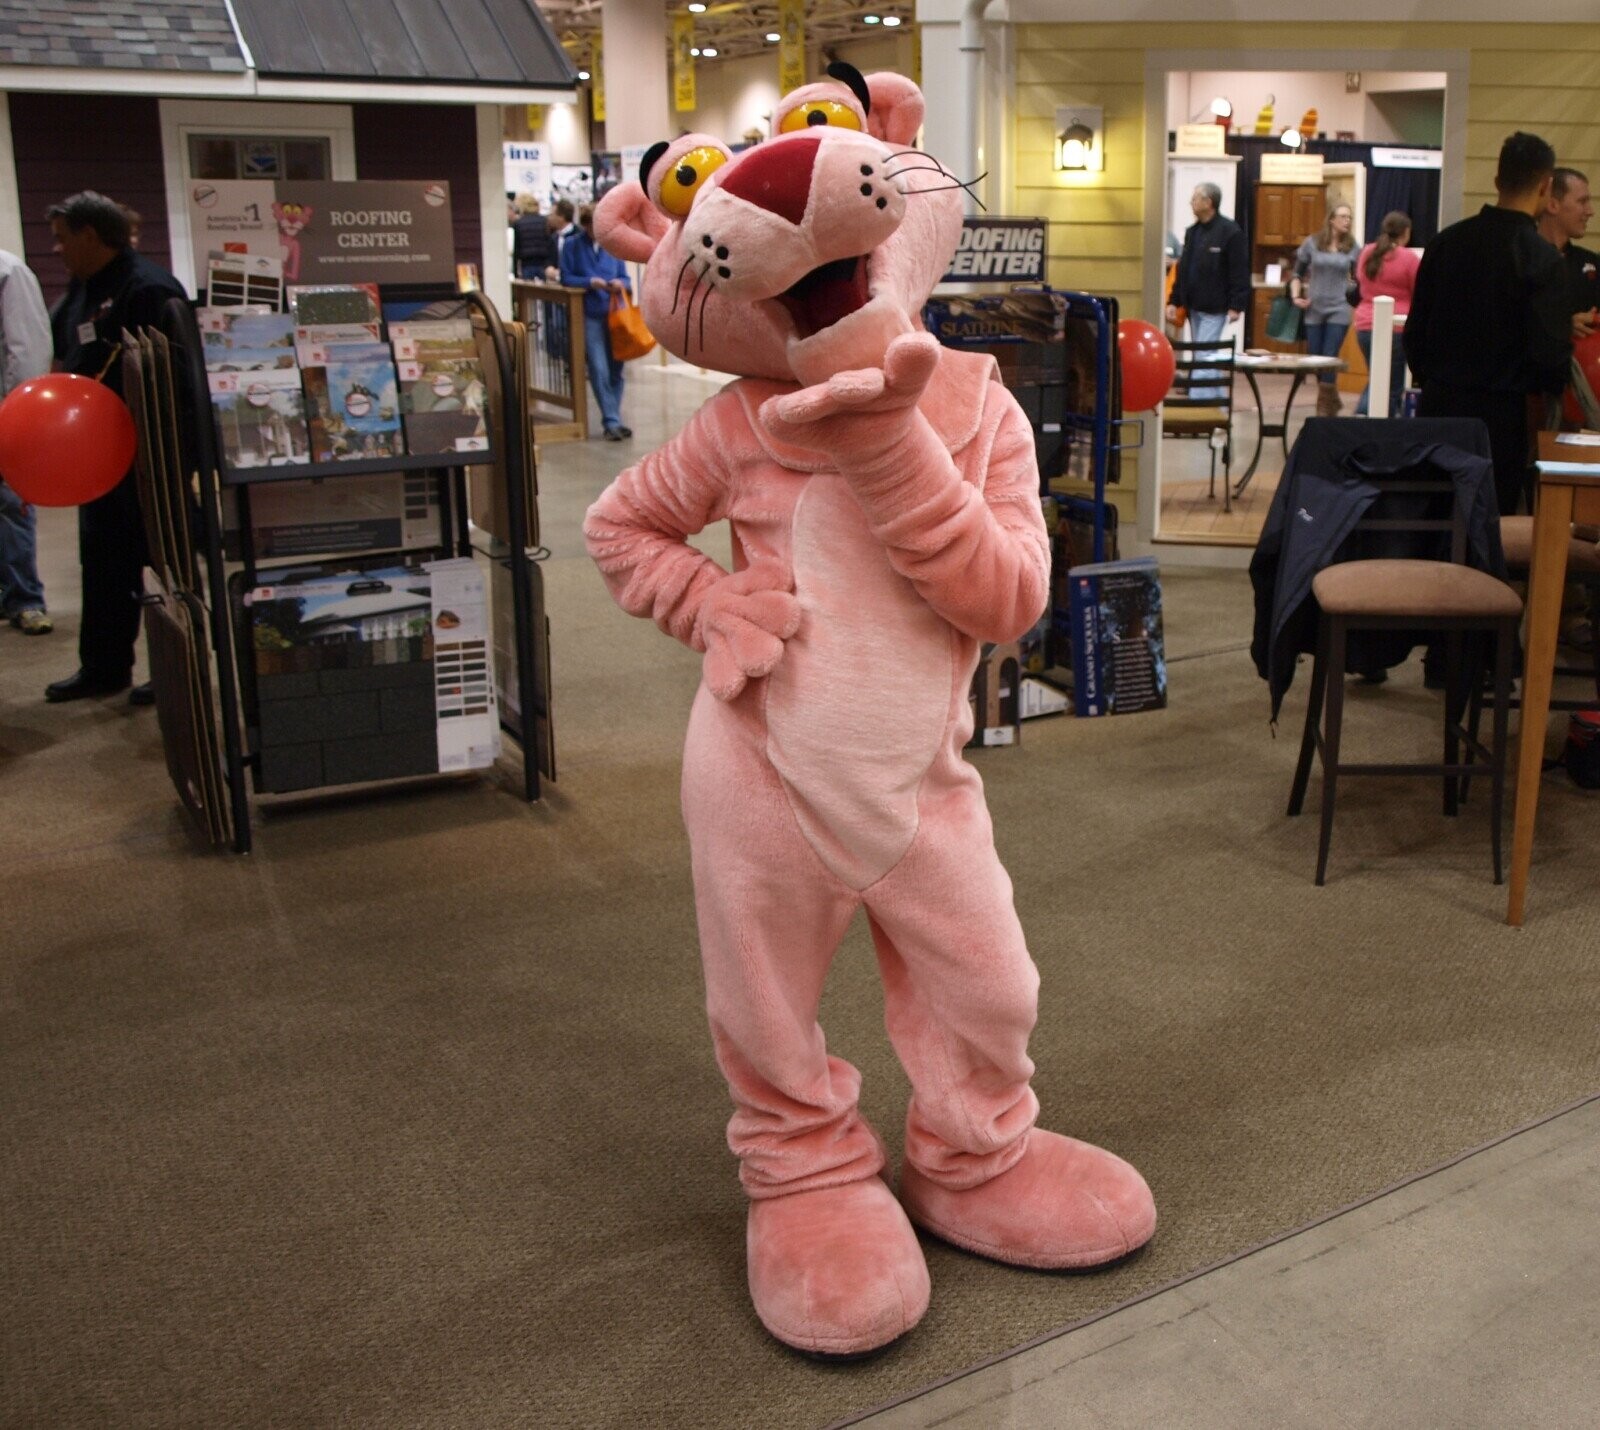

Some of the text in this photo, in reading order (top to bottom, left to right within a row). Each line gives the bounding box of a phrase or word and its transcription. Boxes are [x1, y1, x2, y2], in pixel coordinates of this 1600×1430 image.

[330, 210, 413, 226] ROOFING
[337, 232, 410, 248] CENTER
[955, 227, 1043, 251] OOFING
[945, 251, 1041, 275] ENTER
